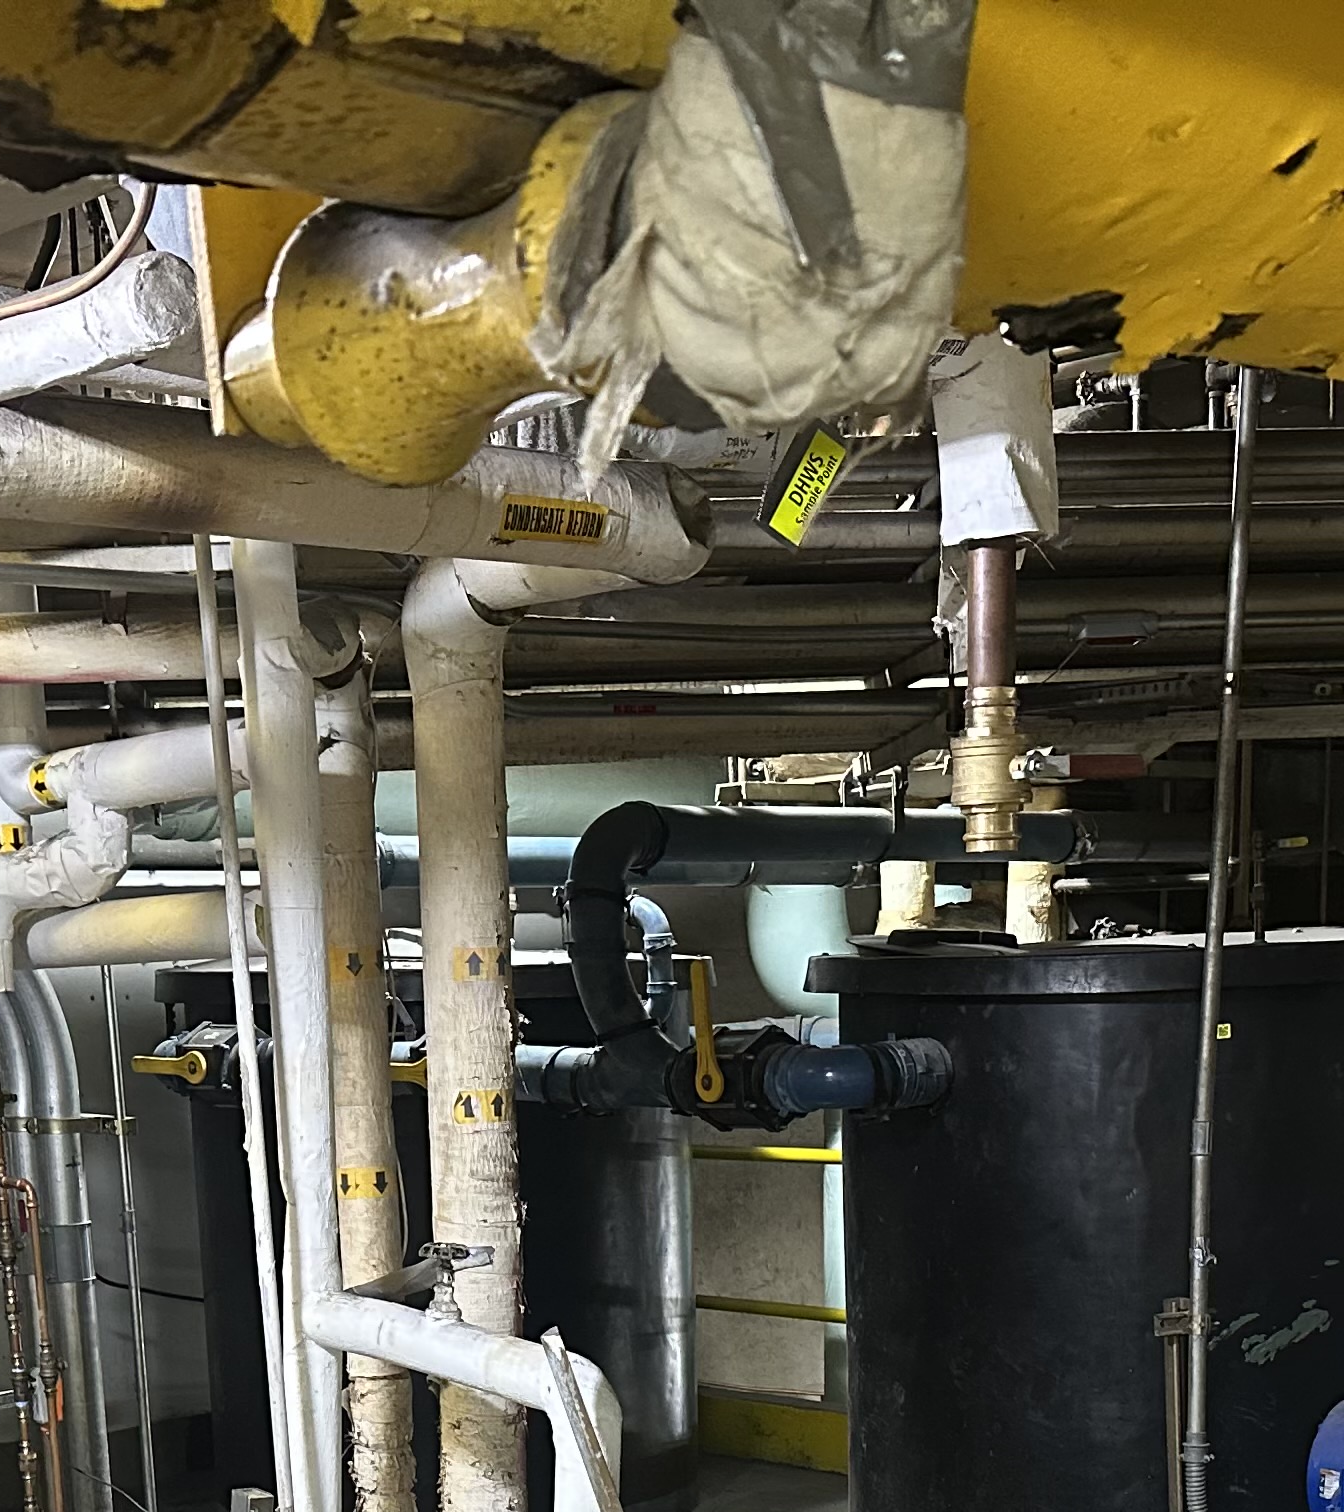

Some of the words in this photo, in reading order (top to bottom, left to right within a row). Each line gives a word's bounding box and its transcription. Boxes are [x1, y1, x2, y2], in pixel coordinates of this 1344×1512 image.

[788, 451, 824, 508] DHWS
[816, 454, 838, 486] Point
[503, 503, 565, 535] CONDENSATE
[565, 509, 605, 539] RETURN
